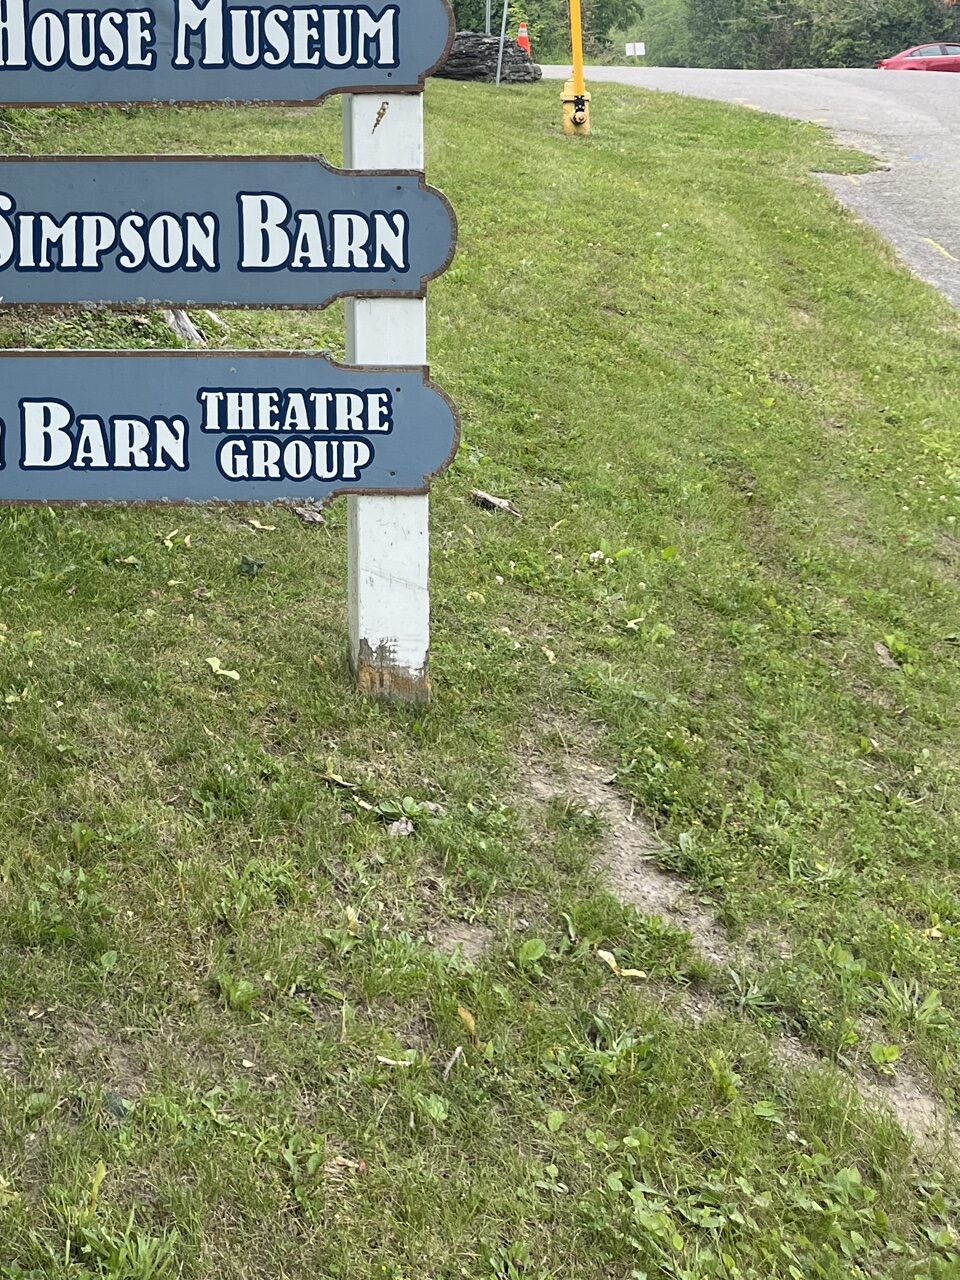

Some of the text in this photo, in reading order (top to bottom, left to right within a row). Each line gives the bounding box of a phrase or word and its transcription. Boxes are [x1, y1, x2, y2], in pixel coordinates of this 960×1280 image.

[239, 194, 407, 269] BARN
[22, 401, 186, 469] BARN
[201, 389, 390, 432] THEATRE
[220, 439, 371, 480] GROUP
